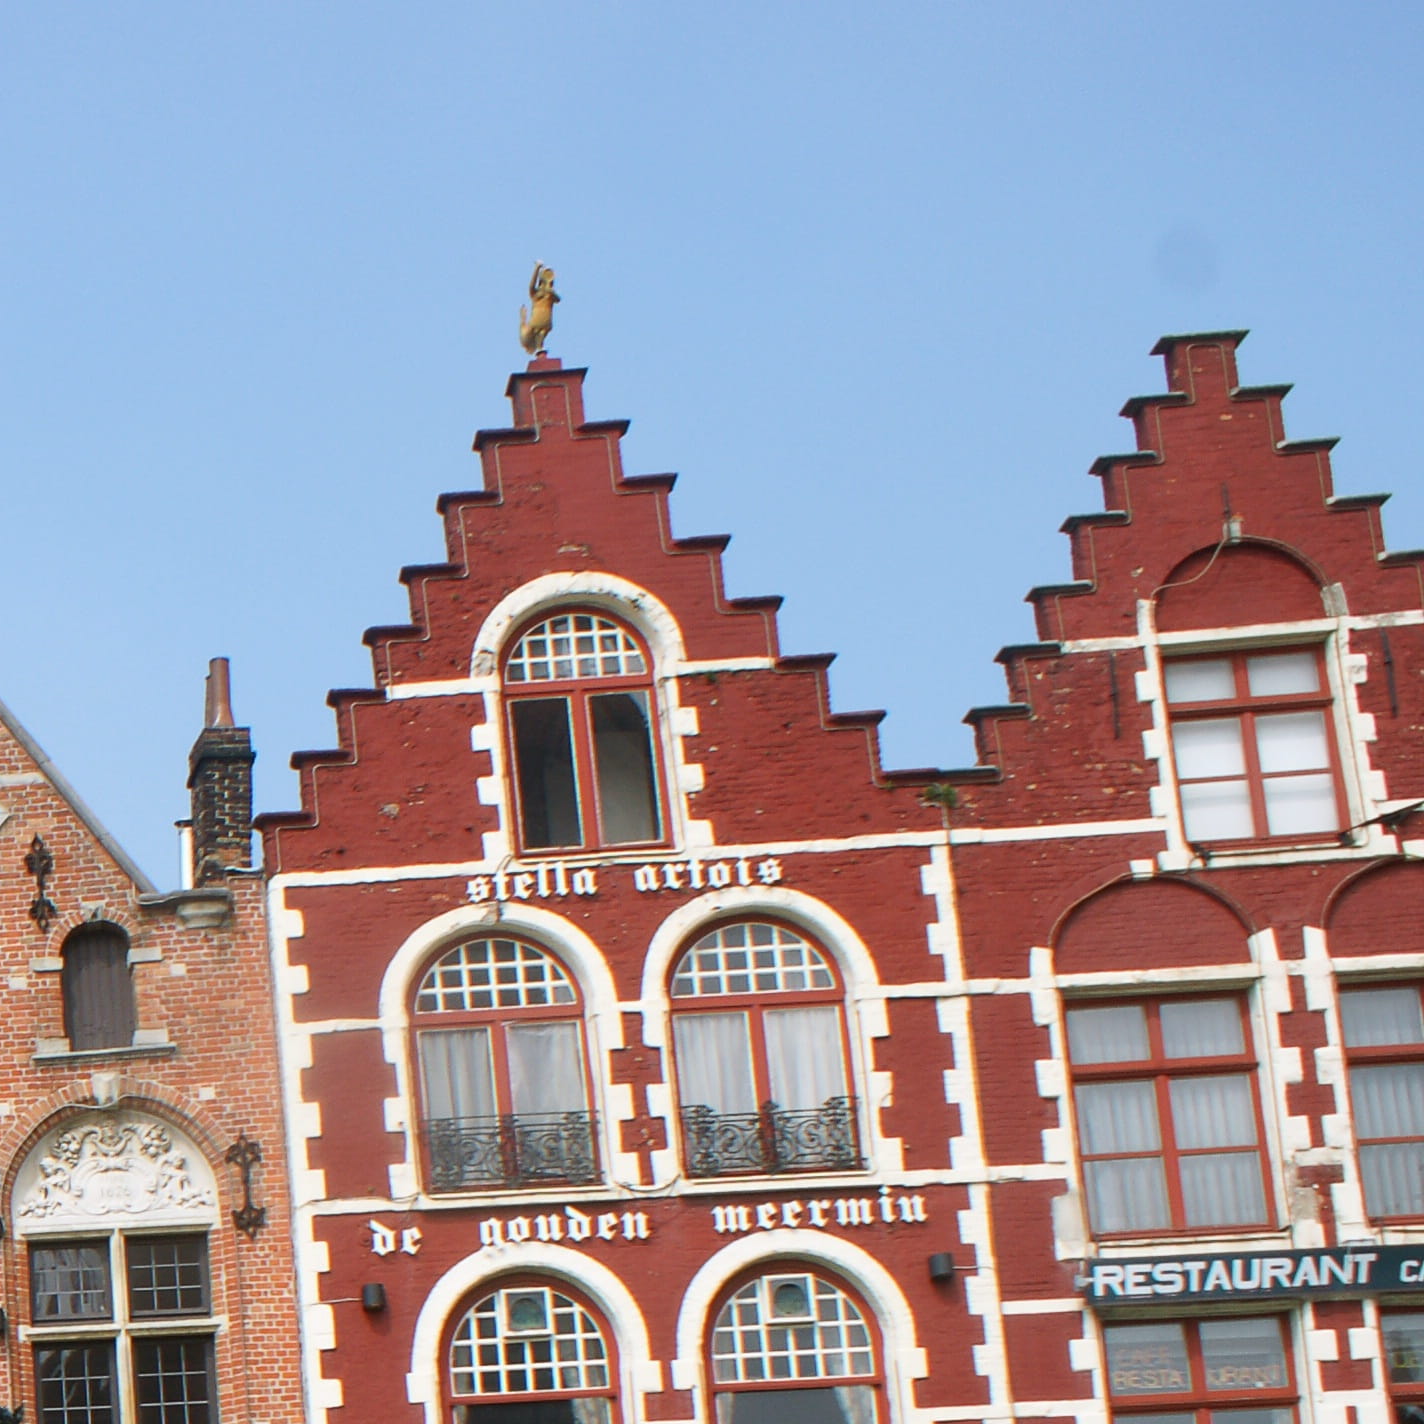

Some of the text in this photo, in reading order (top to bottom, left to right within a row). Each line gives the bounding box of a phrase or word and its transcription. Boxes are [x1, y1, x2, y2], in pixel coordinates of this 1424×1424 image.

[466, 856, 783, 902] stella artois
[369, 1186, 927, 1260] de gouden meermin
[1092, 1252, 1378, 1297] RESTAURANT
